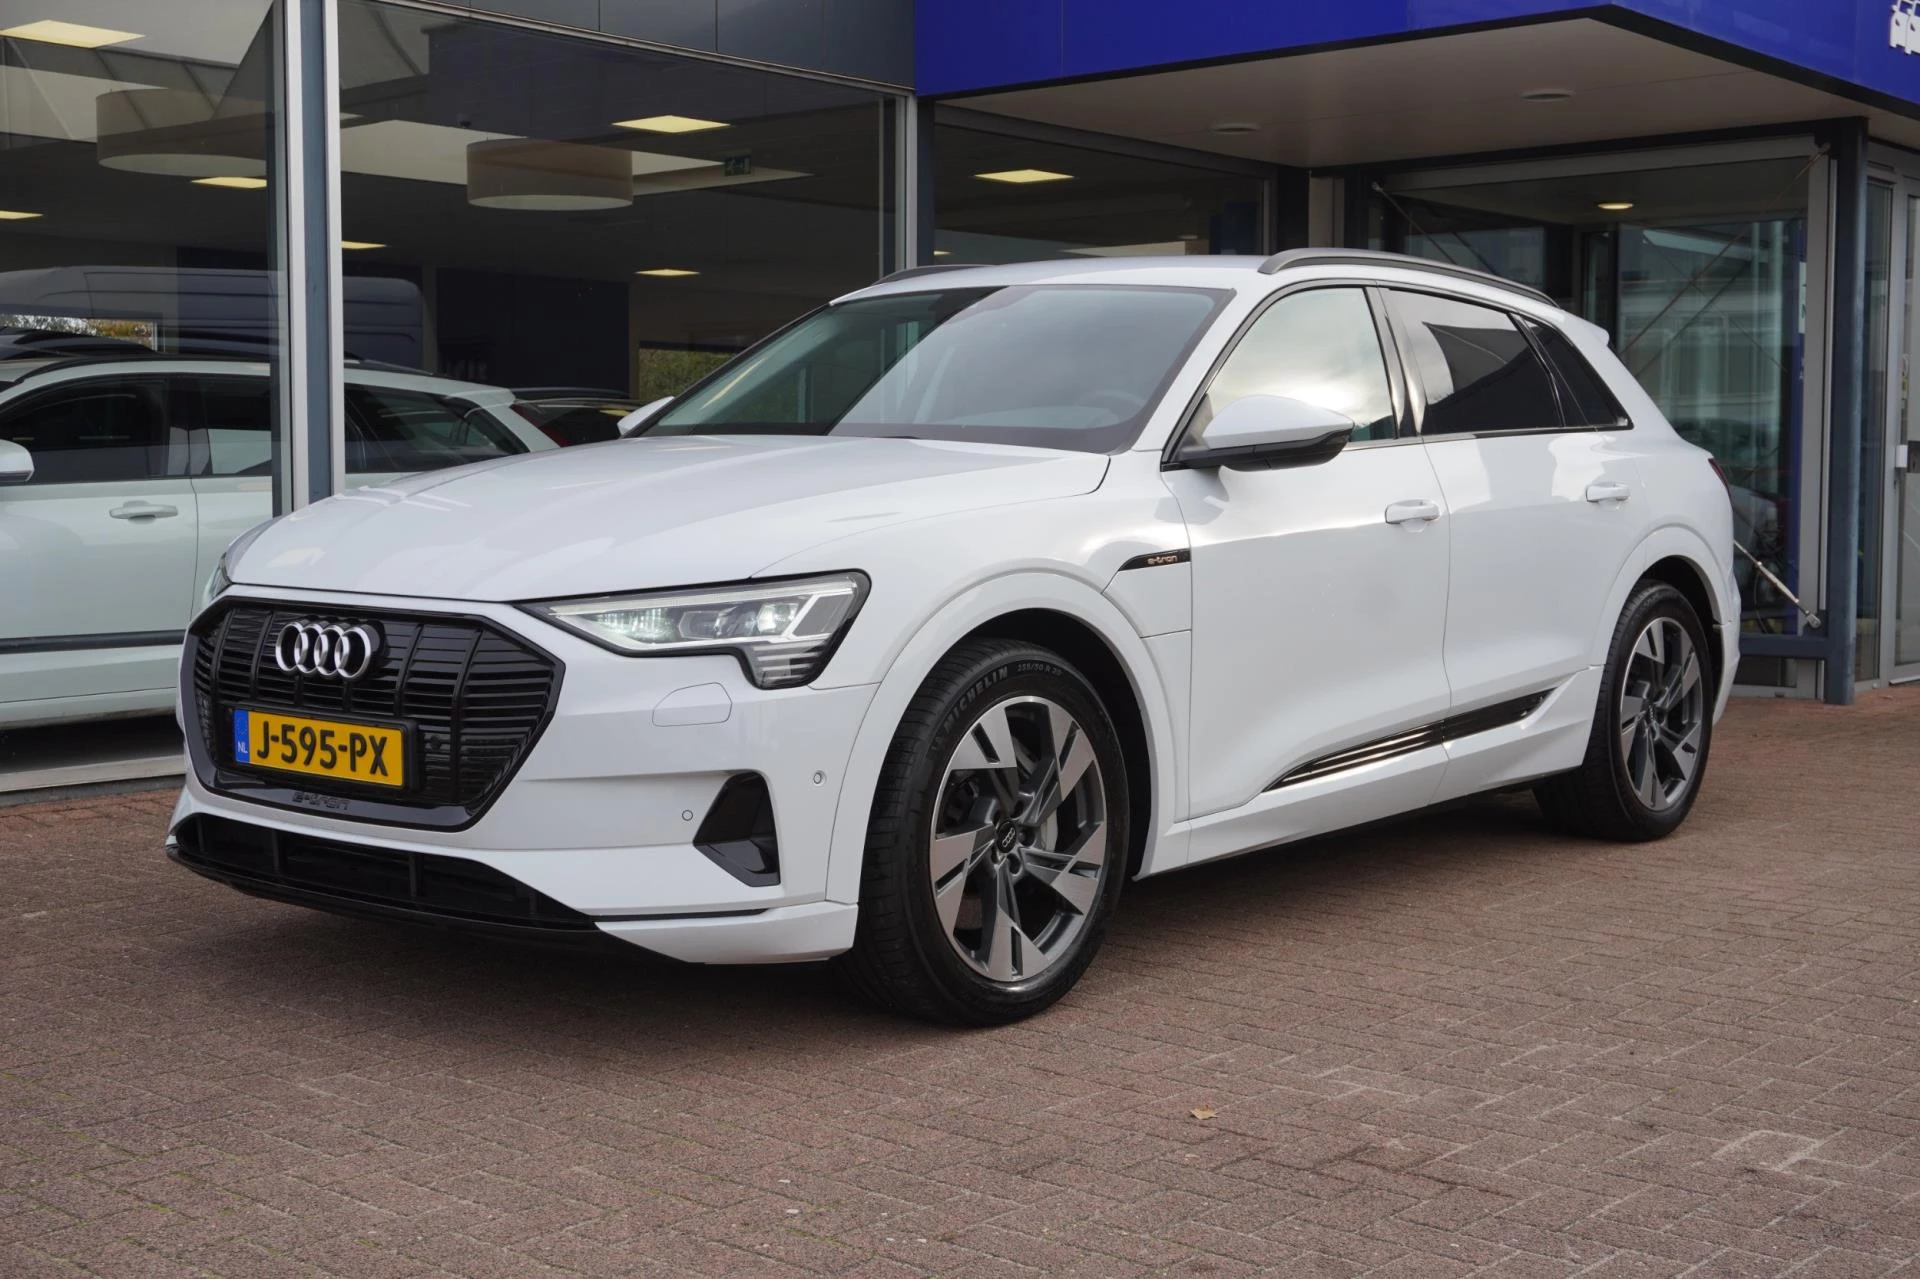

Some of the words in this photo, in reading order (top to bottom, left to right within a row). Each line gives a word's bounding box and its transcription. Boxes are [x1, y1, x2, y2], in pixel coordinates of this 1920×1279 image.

[1147, 555, 1178, 565] e-tron
[943, 665, 1009, 734] MICHELIN
[237, 741, 248, 754] NL
[256, 720, 388, 777] J-595-PX
